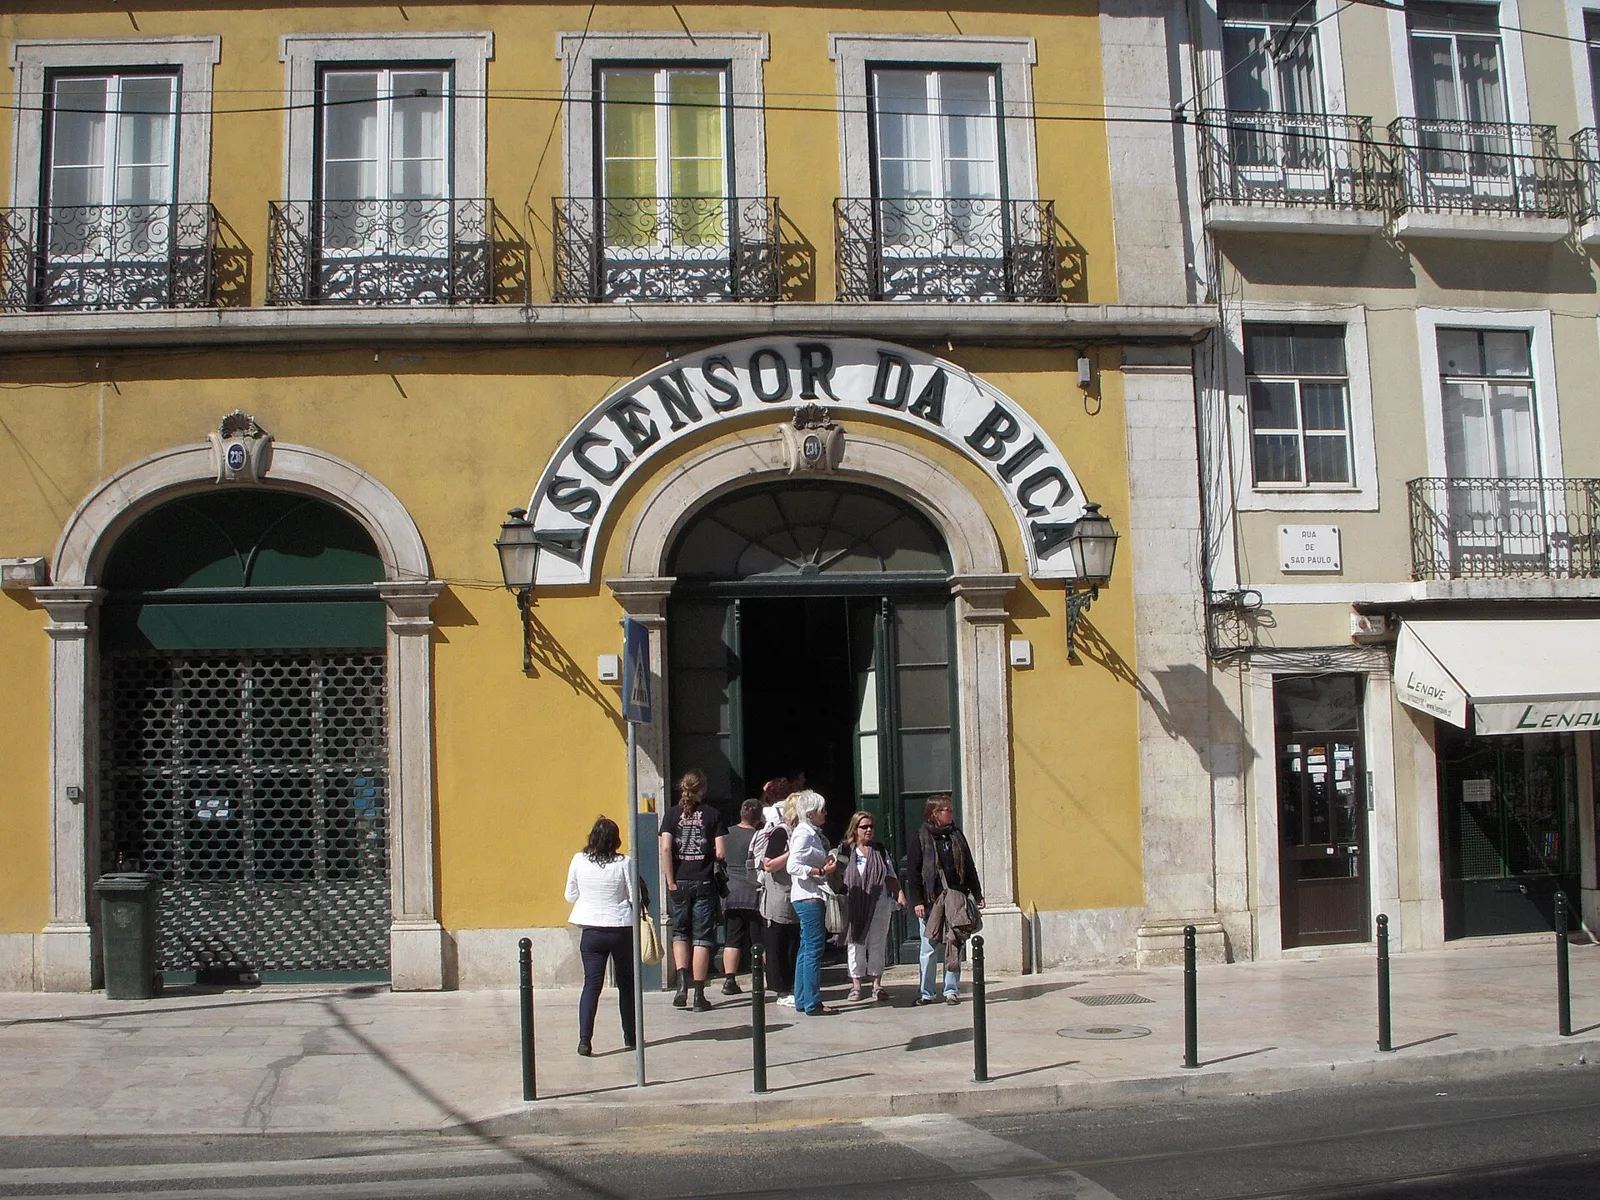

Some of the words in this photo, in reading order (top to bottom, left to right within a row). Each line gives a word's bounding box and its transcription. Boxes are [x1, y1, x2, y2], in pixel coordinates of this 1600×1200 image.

[230, 450, 242, 463] 236
[536, 342, 840, 565] ASCENSOR
[867, 349, 946, 428] DA
[964, 401, 1078, 558] BICA
[1305, 543, 1315, 551] DE
[1307, 556, 1331, 564] PAULO
